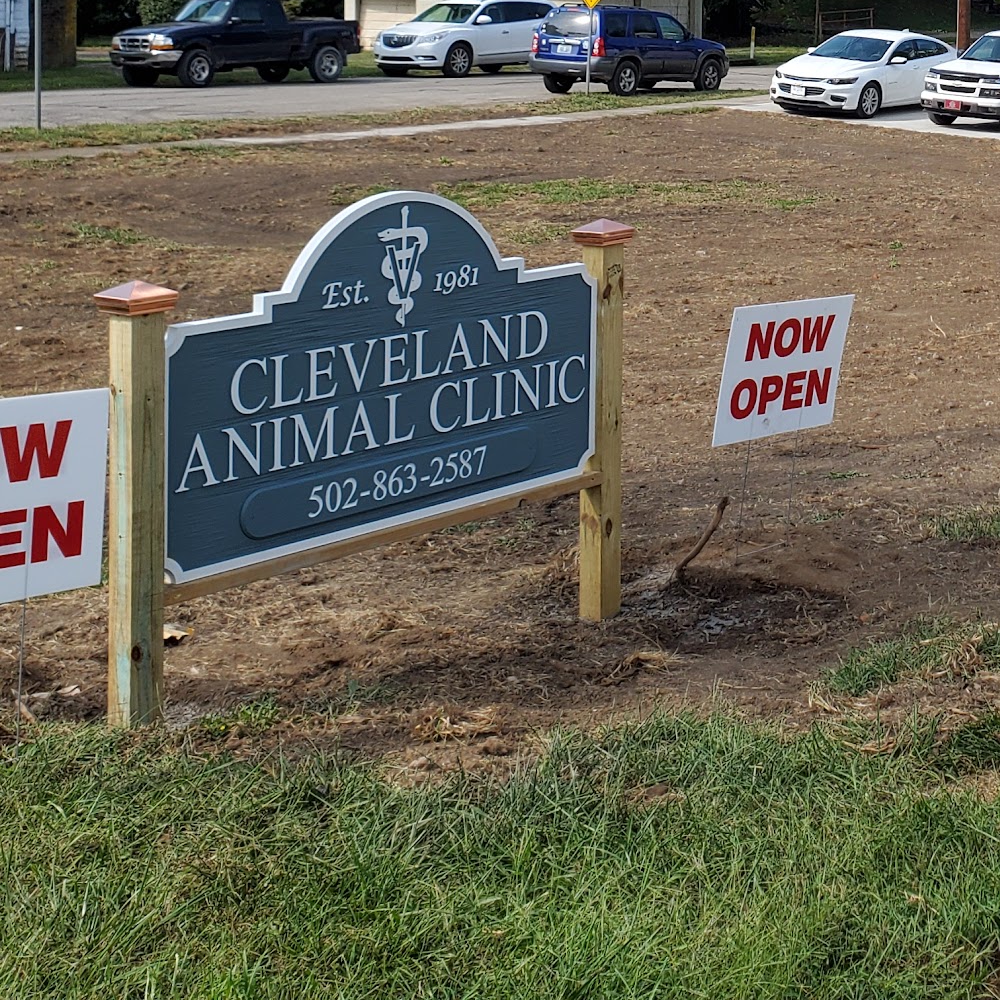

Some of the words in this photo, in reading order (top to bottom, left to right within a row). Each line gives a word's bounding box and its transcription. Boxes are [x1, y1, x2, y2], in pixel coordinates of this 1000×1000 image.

[322, 279, 370, 310] Est.
[433, 264, 479, 295] 1981
[230, 309, 549, 416] CLEVELAND
[744, 314, 837, 362] NOW
[174, 393, 415, 494] ANIMAL
[429, 354, 586, 434] CLINIC
[729, 366, 833, 421] OPEN
[308, 445, 488, 519] 502-863-2587
